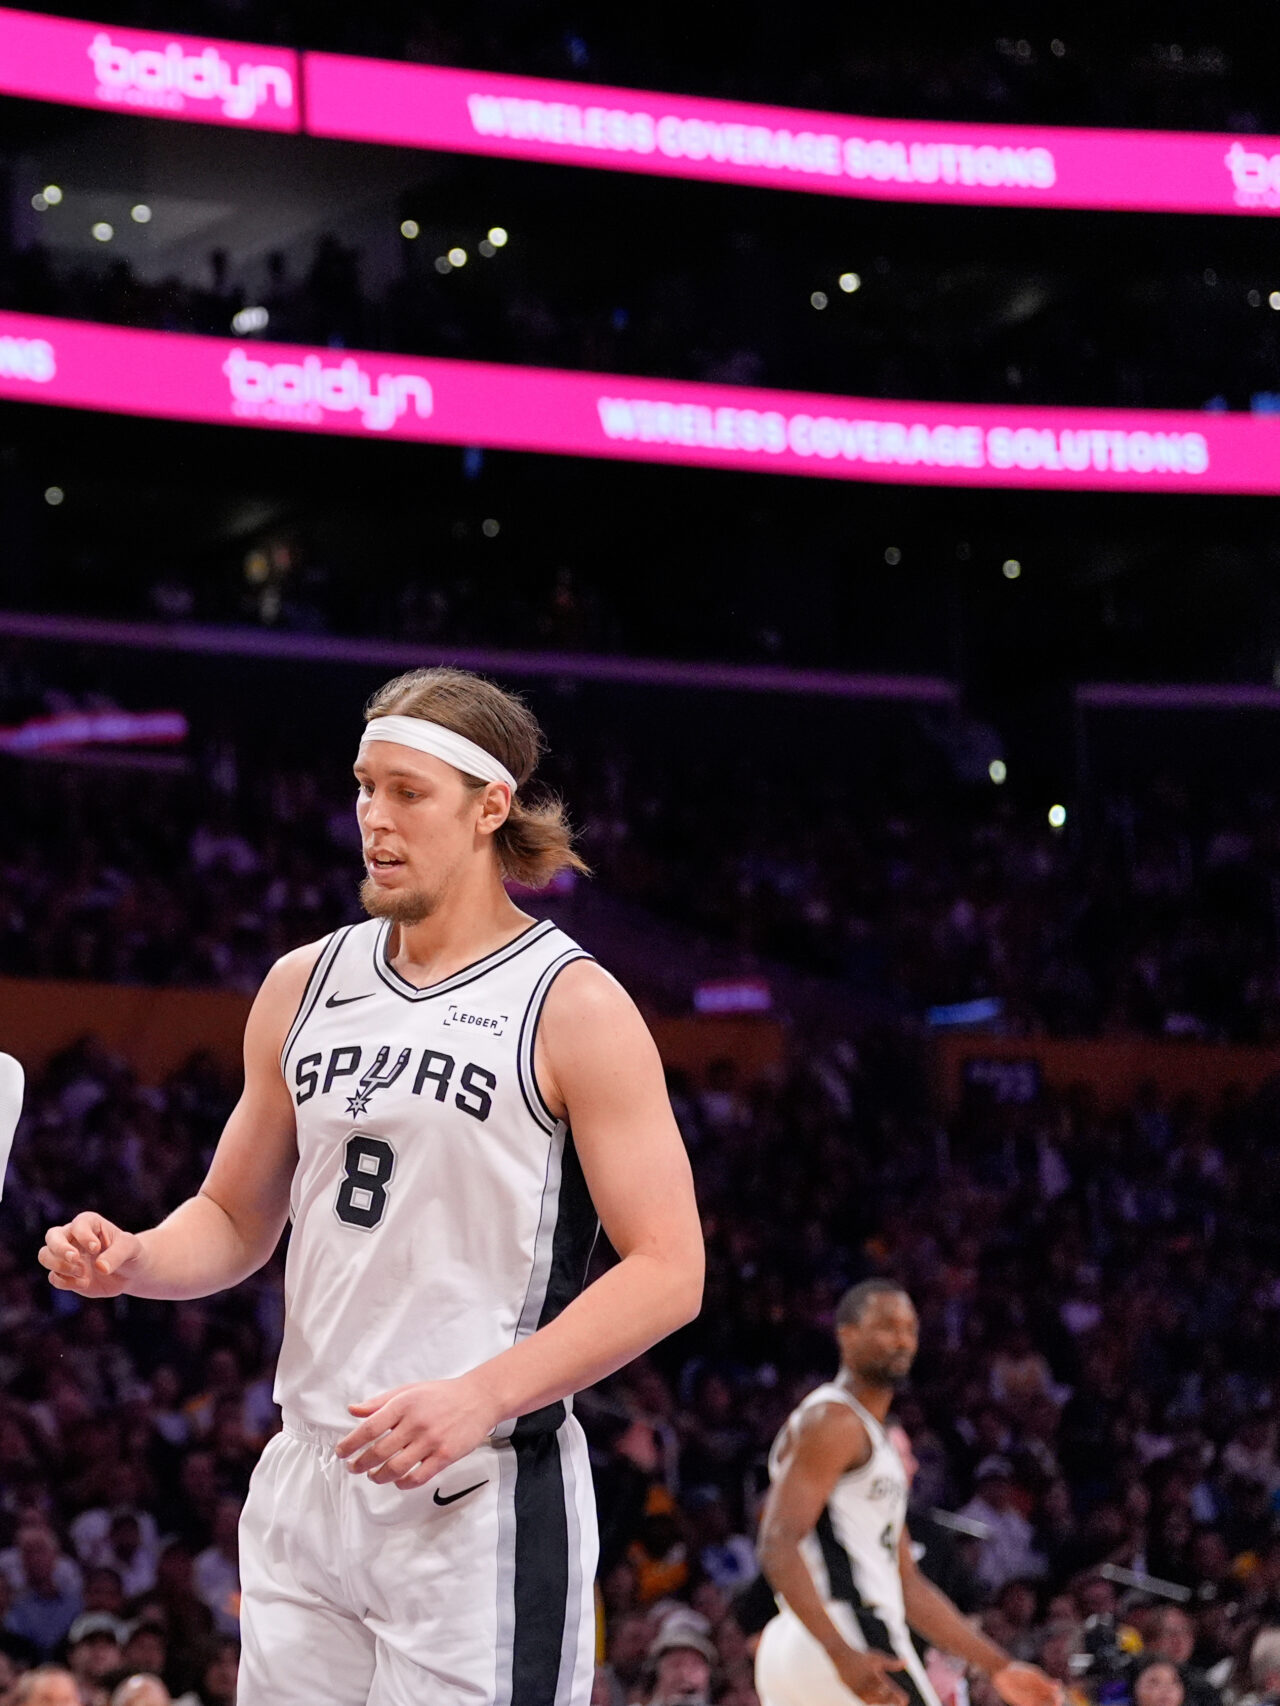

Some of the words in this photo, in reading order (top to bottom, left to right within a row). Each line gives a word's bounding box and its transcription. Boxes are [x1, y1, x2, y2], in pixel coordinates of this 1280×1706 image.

[467, 93, 655, 154] WIRELESS
[657, 115, 842, 176] COVERAGE
[843, 137, 1056, 189] SOLUTIONS
[597, 397, 787, 454] WIRELESS
[788, 414, 985, 469] COVERAGE
[986, 426, 1209, 474] SOLUTIONS
[452, 1011, 499, 1030] LEDGER
[295, 1045, 497, 1123] SPURS
[333, 1128, 399, 1234] 8
